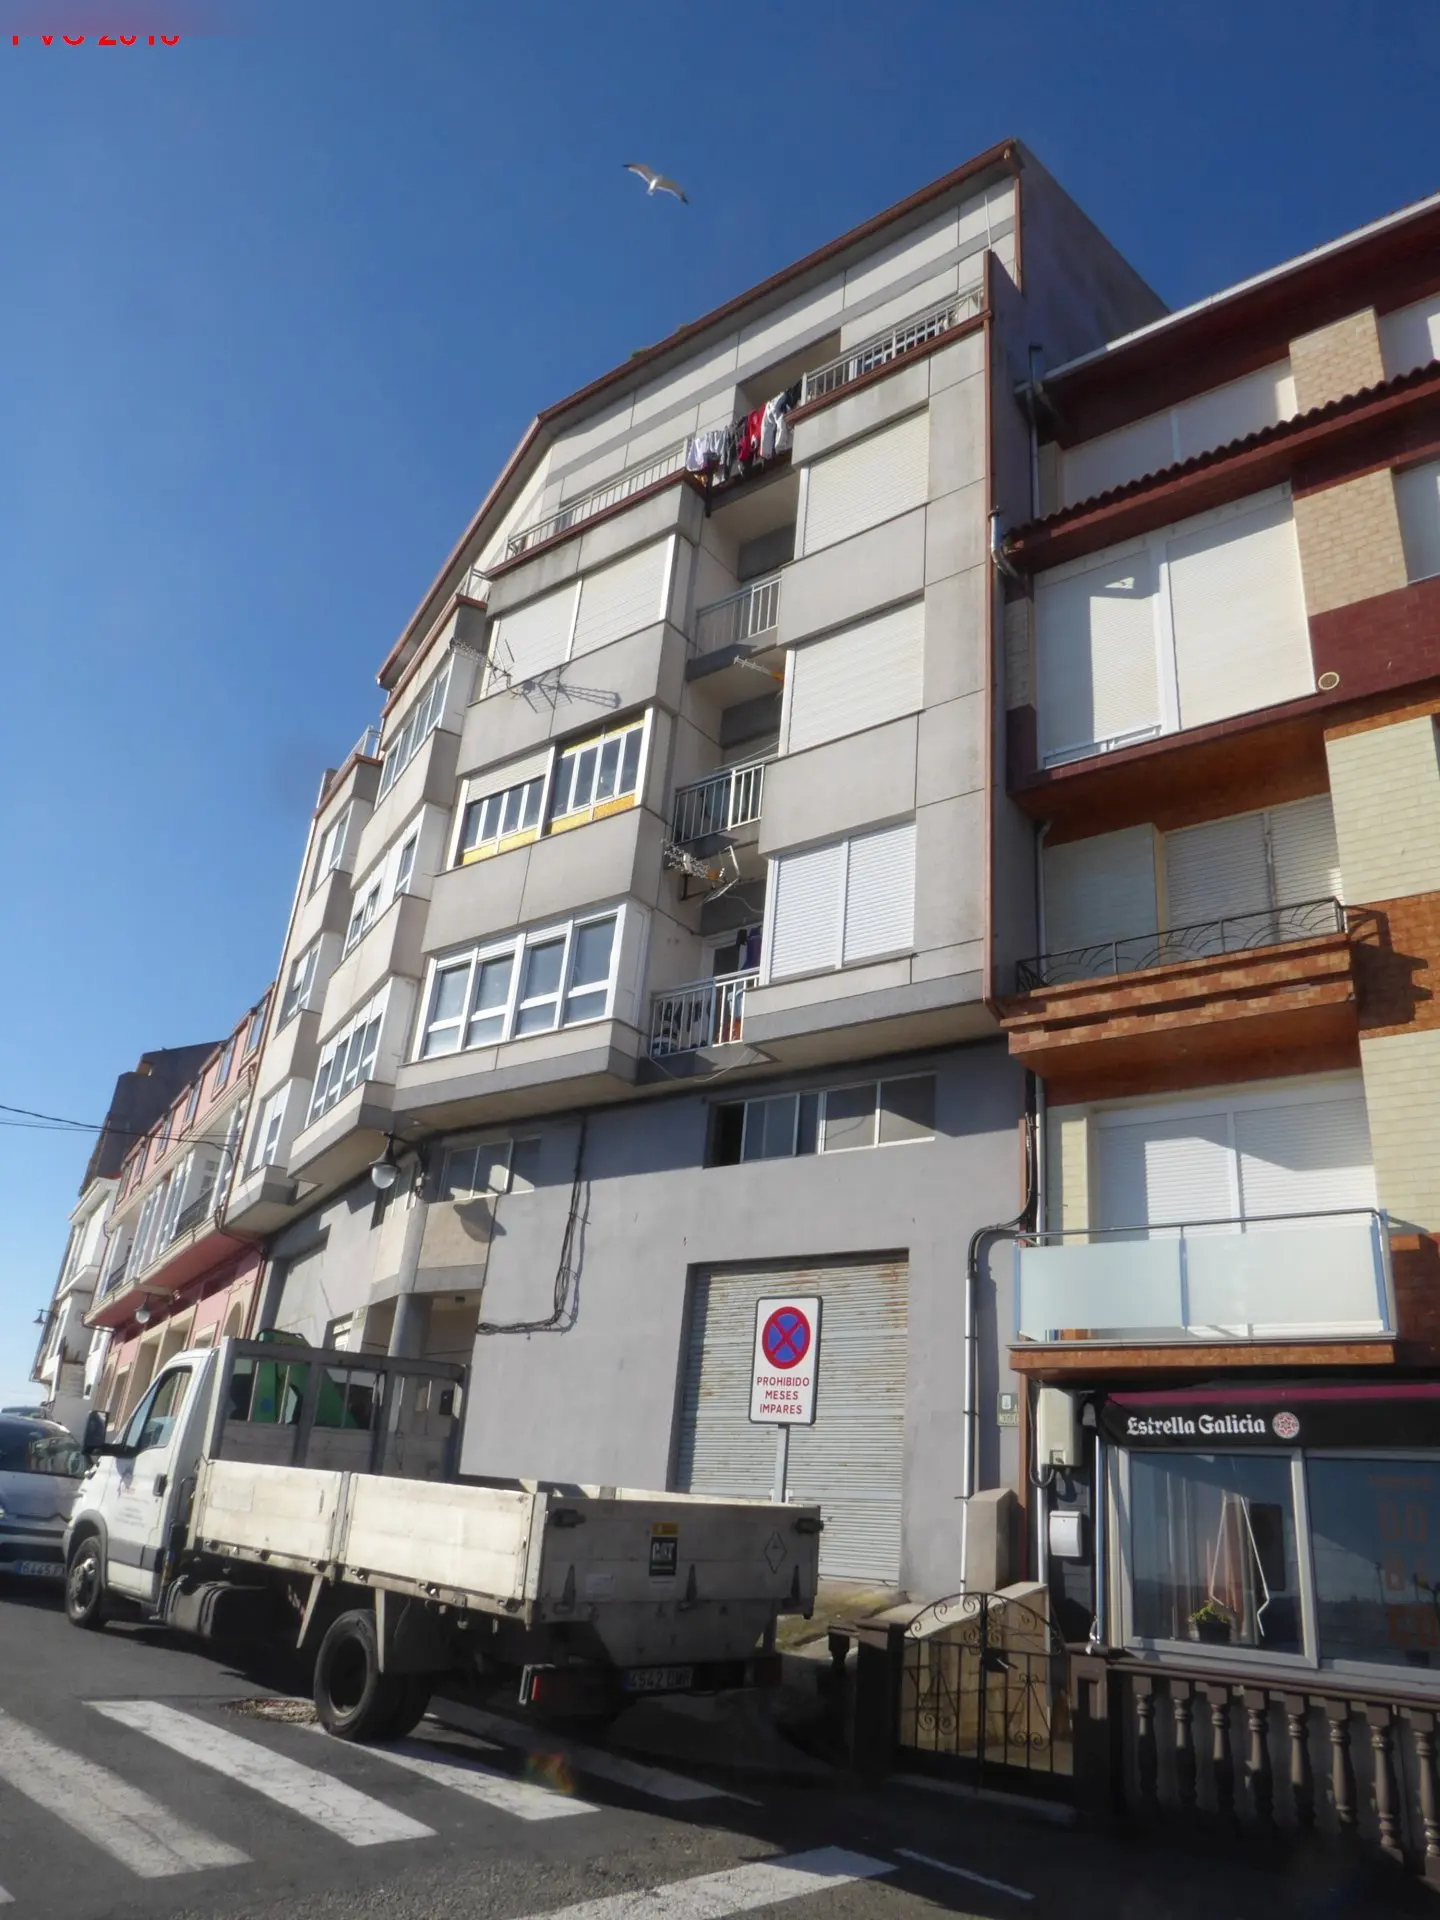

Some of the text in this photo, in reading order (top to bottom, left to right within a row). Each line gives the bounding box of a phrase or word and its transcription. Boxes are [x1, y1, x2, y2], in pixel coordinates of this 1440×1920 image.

[756, 1376, 810, 1387] PROHIBIDO
[765, 1390, 799, 1401] MESES
[759, 1403, 803, 1415] IMPARES
[1127, 1414, 1266, 1436] Estrella Galicia
